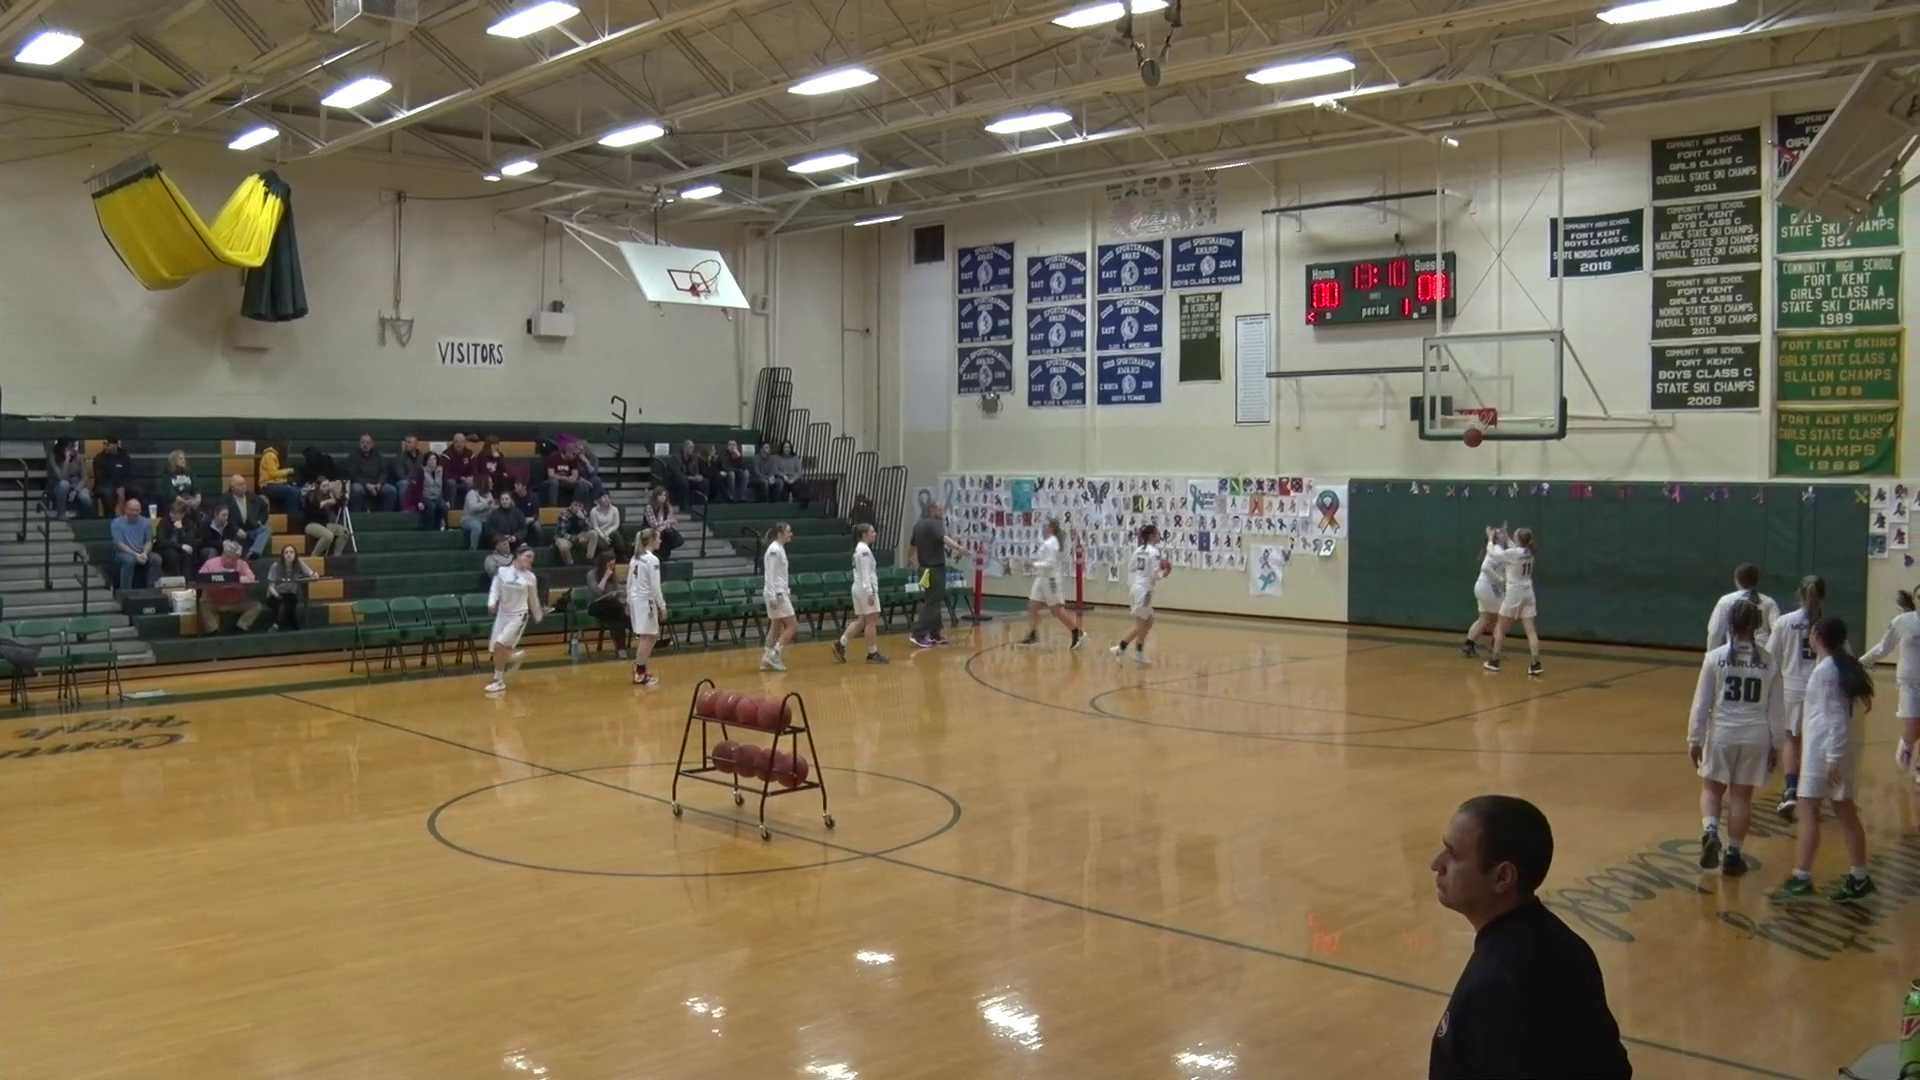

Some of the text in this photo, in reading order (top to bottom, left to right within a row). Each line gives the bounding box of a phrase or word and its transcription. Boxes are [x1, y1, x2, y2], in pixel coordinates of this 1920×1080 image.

[1677, 146, 1733, 160] FORT KENT
[1669, 156, 1744, 171] GIRLS CLASS C
[1656, 166, 1757, 185] OVERALL STATE SKI CHAMPS
[1694, 183, 1717, 192] 2011
[1677, 210, 1735, 222] FORT KENT
[1878, 206, 1884, 218] A
[1671, 222, 1696, 230] BOYS
[1699, 218, 1731, 228] CLASS
[1781, 218, 1895, 238] STATE SKI HAMPS
[1570, 228, 1622, 240] FORT KENT
[1660, 224, 1754, 240] ALPINE STATE SKI CHAMPS
[1590, 237, 1620, 246] CLASS
[1655, 240, 1679, 250] NORDIC
[1716, 236, 1728, 246] SKI
[1730, 234, 1759, 244] CHAMPS
[1574, 244, 1640, 259] NORDIC CHAMPIONS
[1656, 244, 1758, 260] OVERALL STATE SKI CHAMPS
[1176, 259, 1236, 272] EAST 2014
[1580, 261, 1612, 272] 2018
[1693, 257, 1718, 266] 2010
[1782, 258, 1894, 274] COMMUNITY HIGH SCHOOL
[1102, 270, 1117, 278] EAST
[1312, 259, 1446, 280] Home Guess
[1804, 272, 1871, 286] FORT KENT
[1313, 282, 1338, 308] 00
[1677, 286, 1734, 296] FORT KENT
[1790, 285, 1884, 300] GIRLS CLASS A
[1669, 294, 1743, 306] GIRLS CLASS C
[1782, 298, 1894, 313] STATE SKI CHAMPS
[1362, 304, 1390, 318] period
[1659, 302, 1754, 317] NORDIC STATE SKI CHAMPS
[1656, 314, 1758, 328] OVERALL STATE SKI CHAMPS
[1820, 312, 1853, 325] 1989
[1692, 327, 1716, 336] 2010
[1781, 338, 1897, 351] FORT KENT SKIING
[438, 342, 503, 365] VISITORS
[1780, 352, 1898, 366] GIRLS STATE CLASS A
[1676, 358, 1734, 367] FORT KENT
[1658, 368, 1753, 379] BOYS CLASS C
[1784, 369, 1892, 382] SLALOM CHAMPS
[1656, 380, 1755, 394] STATE SKI CHAMPS
[1687, 396, 1722, 406] 2008
[1781, 414, 1810, 424] FORT
[1816, 414, 1848, 425] KENT
[1779, 427, 1895, 440] GIRLS STATE CLASS A
[1795, 444, 1876, 456] CHAMPS
[1724, 676, 1762, 704] 30
